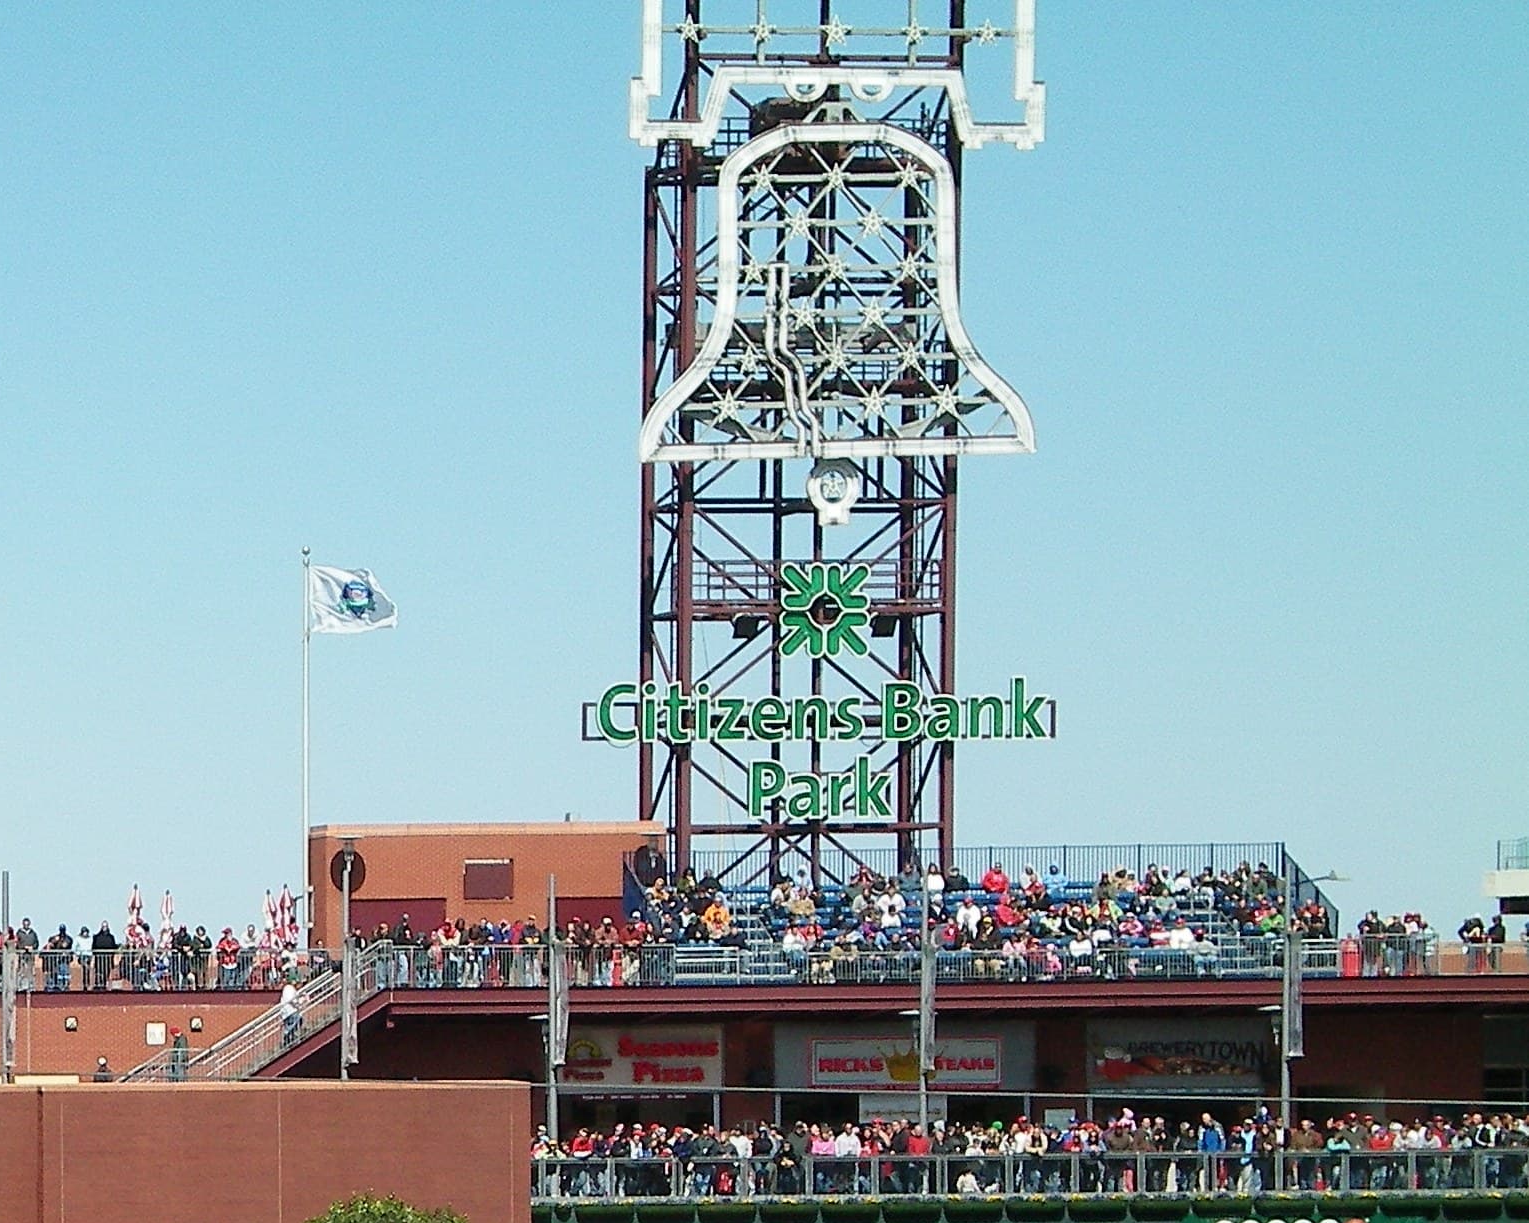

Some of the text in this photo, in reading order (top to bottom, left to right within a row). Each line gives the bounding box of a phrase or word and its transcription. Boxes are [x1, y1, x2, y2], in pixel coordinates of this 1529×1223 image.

[595, 677, 1049, 744] Citizens Bank
[748, 756, 893, 819] Park
[934, 1056, 995, 1071] TEAKS
[1127, 1041, 1264, 1064] BREWERYTOWN
